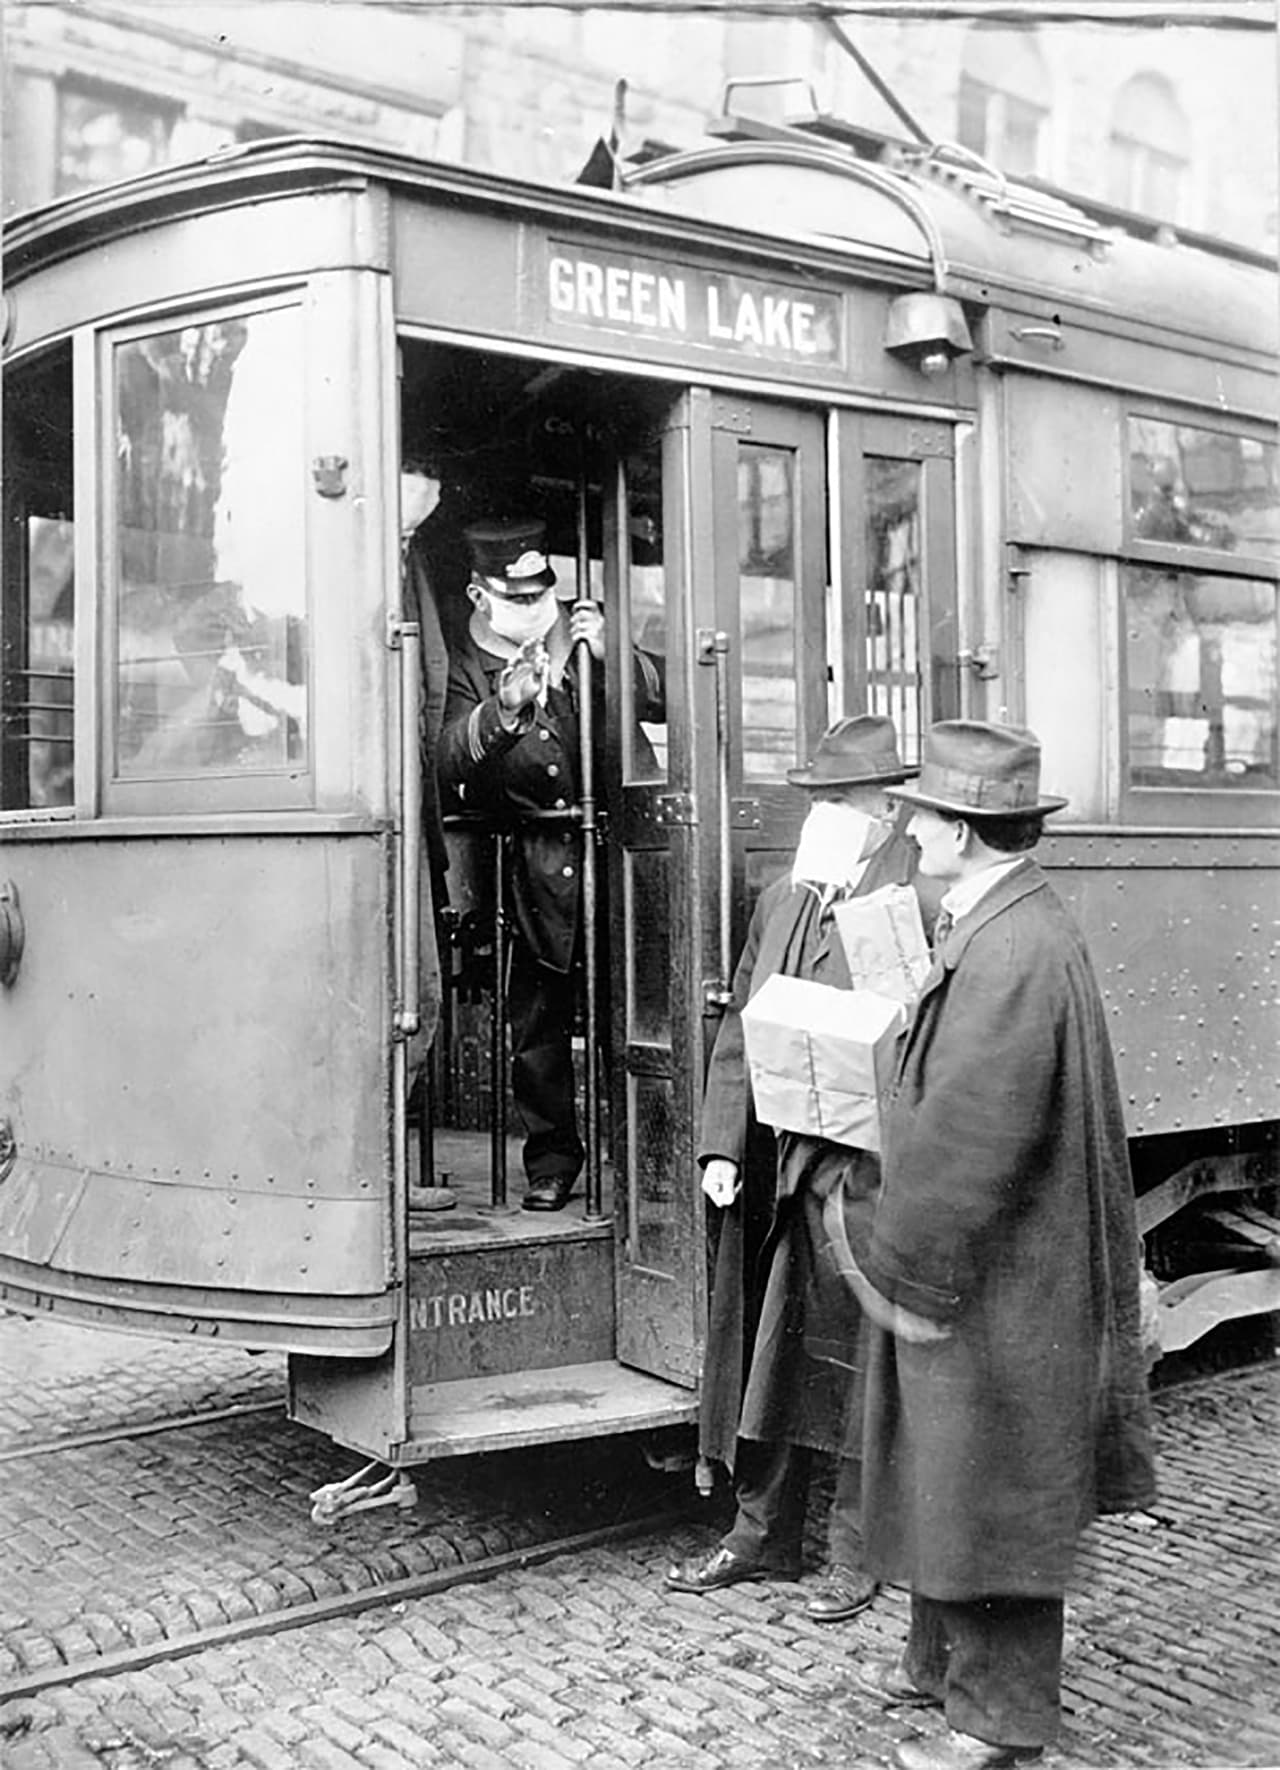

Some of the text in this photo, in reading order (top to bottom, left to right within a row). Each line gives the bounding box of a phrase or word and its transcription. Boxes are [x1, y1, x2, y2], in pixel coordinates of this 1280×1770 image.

[550, 257, 817, 353] GREEN LAKE
[409, 1285, 536, 1331] NTRANCE
